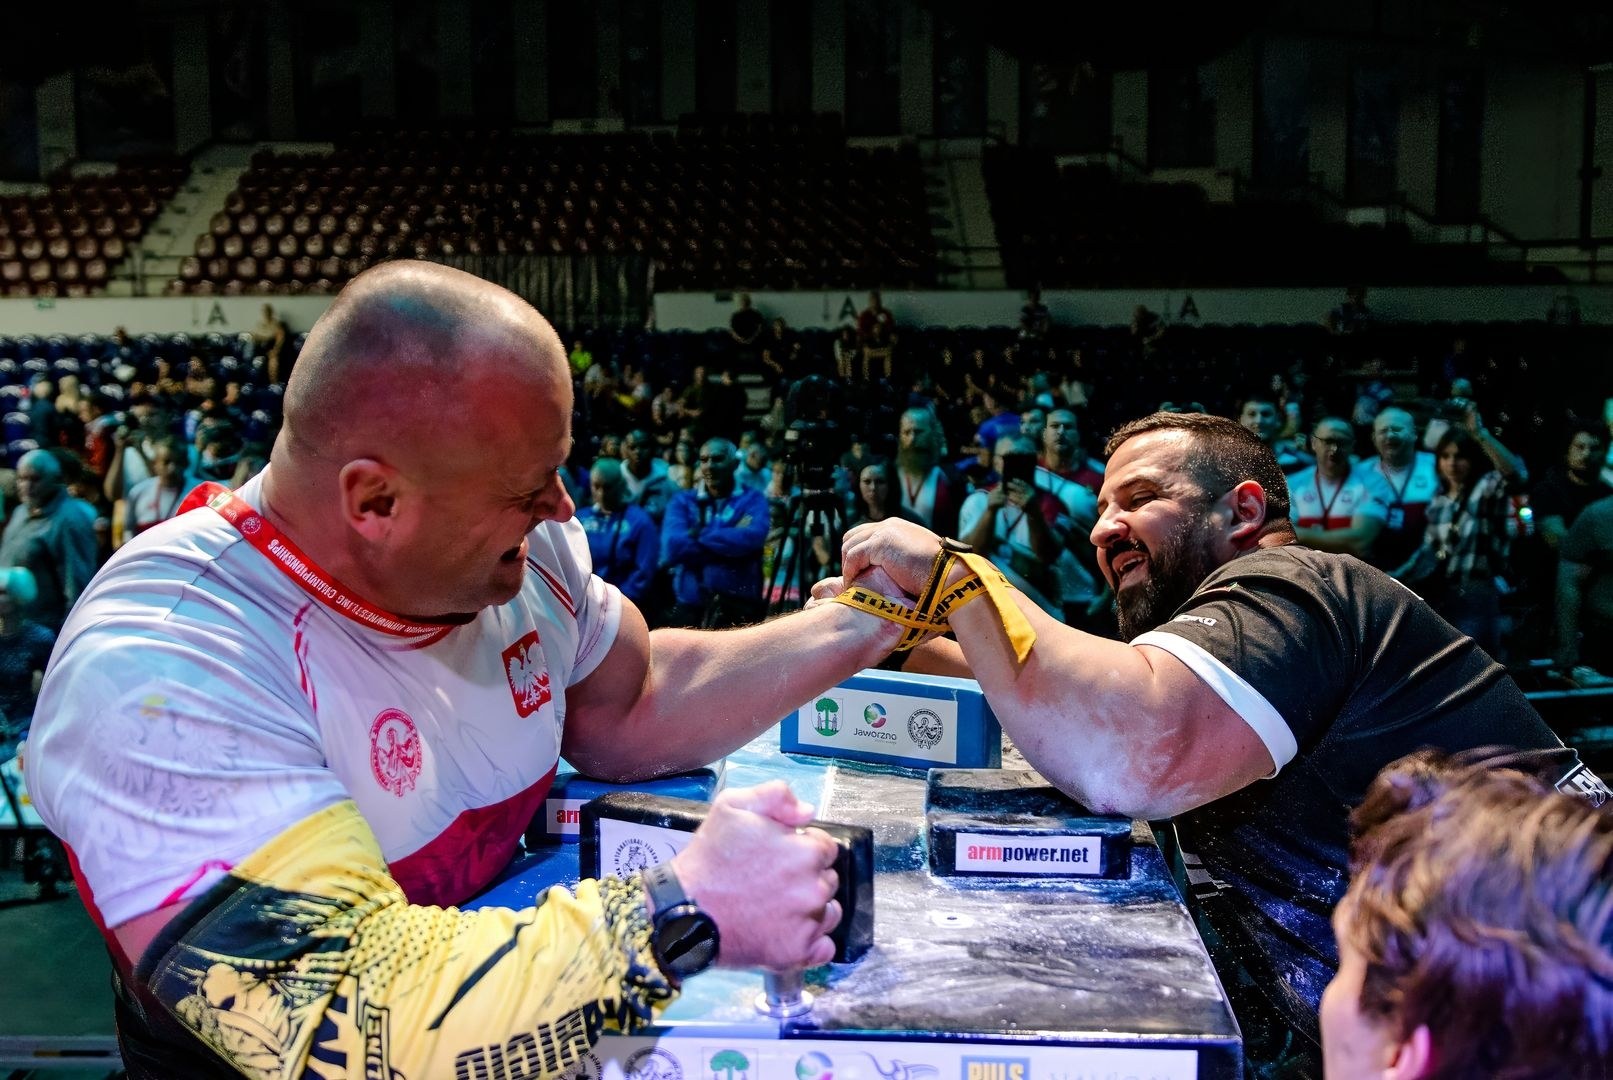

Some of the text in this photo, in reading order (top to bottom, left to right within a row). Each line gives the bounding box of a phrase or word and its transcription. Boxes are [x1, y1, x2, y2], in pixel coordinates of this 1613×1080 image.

[208, 301, 228, 326] A
[839, 295, 858, 320] A
[1180, 295, 1200, 318] A
[267, 538, 337, 599] CHAMPIONSHIPS
[854, 728, 897, 740] Jaworzno
[968, 845, 1088, 863] armpower.net
